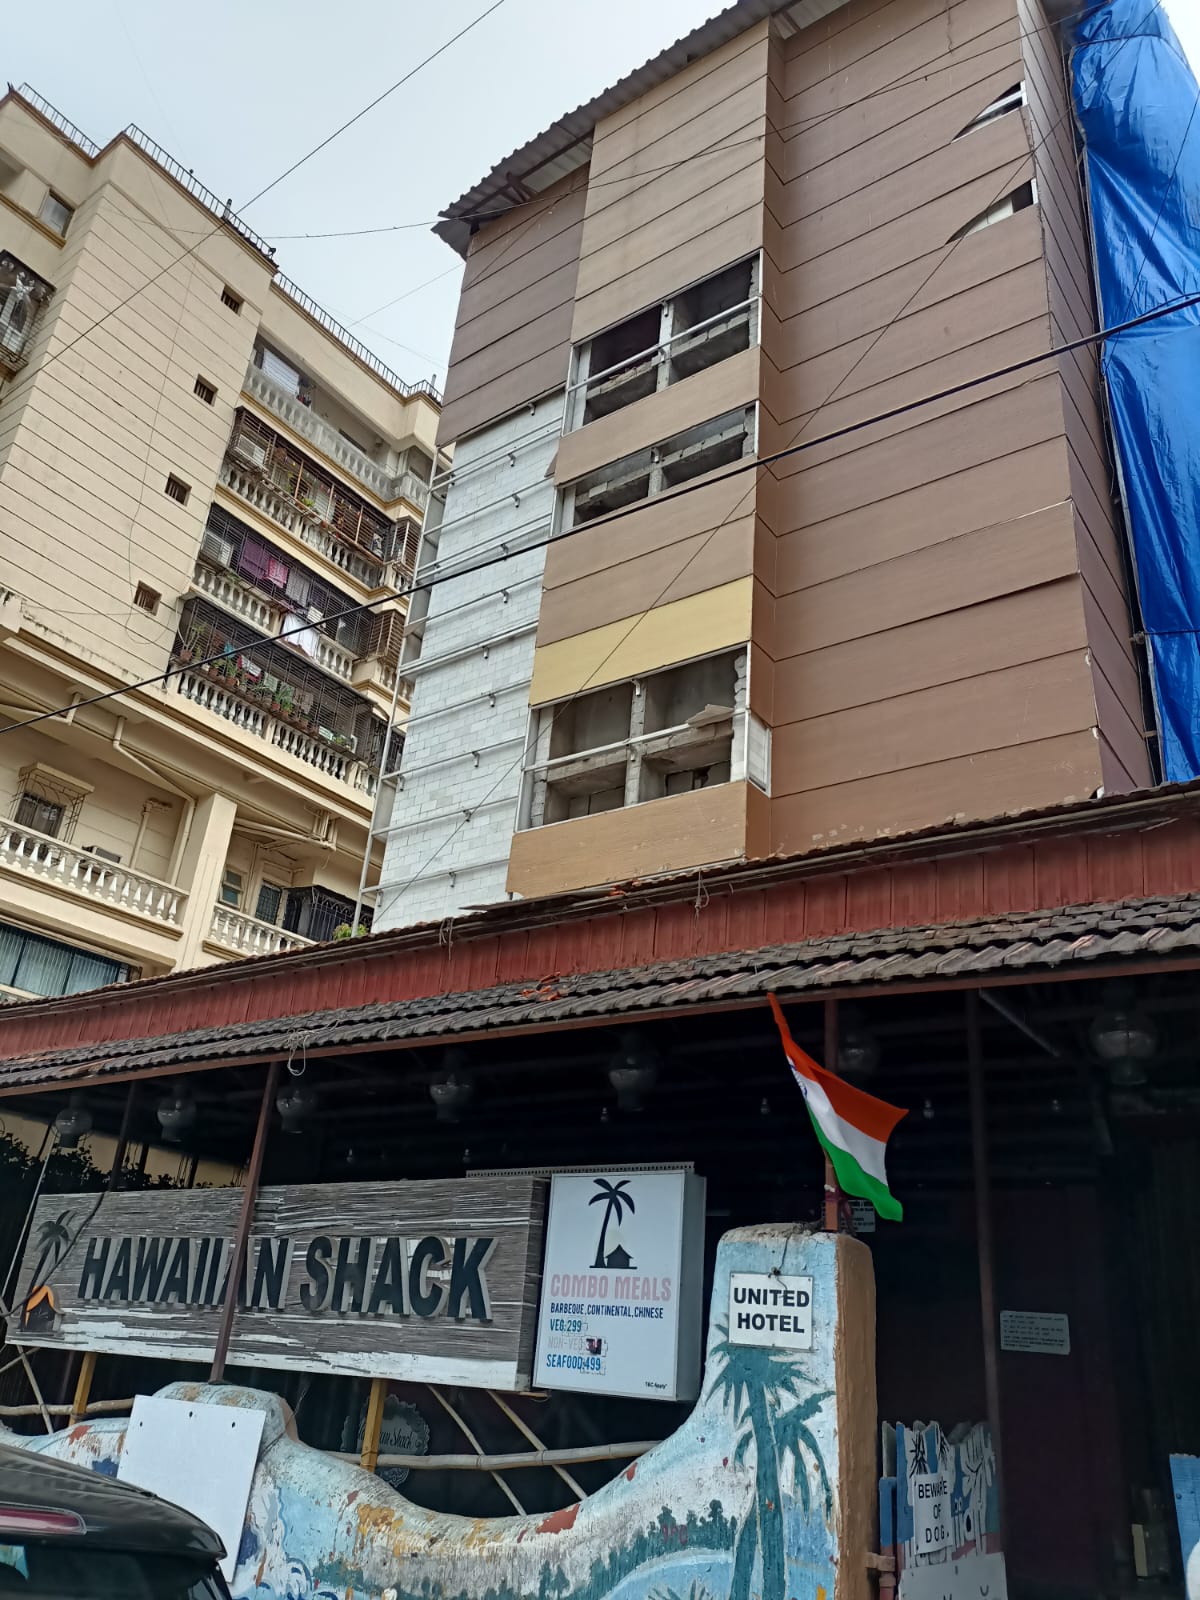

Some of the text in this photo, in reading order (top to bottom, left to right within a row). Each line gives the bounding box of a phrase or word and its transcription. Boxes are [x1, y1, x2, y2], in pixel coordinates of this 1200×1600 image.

[300, 1236, 497, 1320] SHACK
[550, 1274, 672, 1302] COMBO MEALS
[733, 1287, 810, 1308] UNITED
[737, 1312, 805, 1334] HOTEL
[918, 1480, 948, 1499] BEWARE
[933, 1503, 942, 1519] OF
